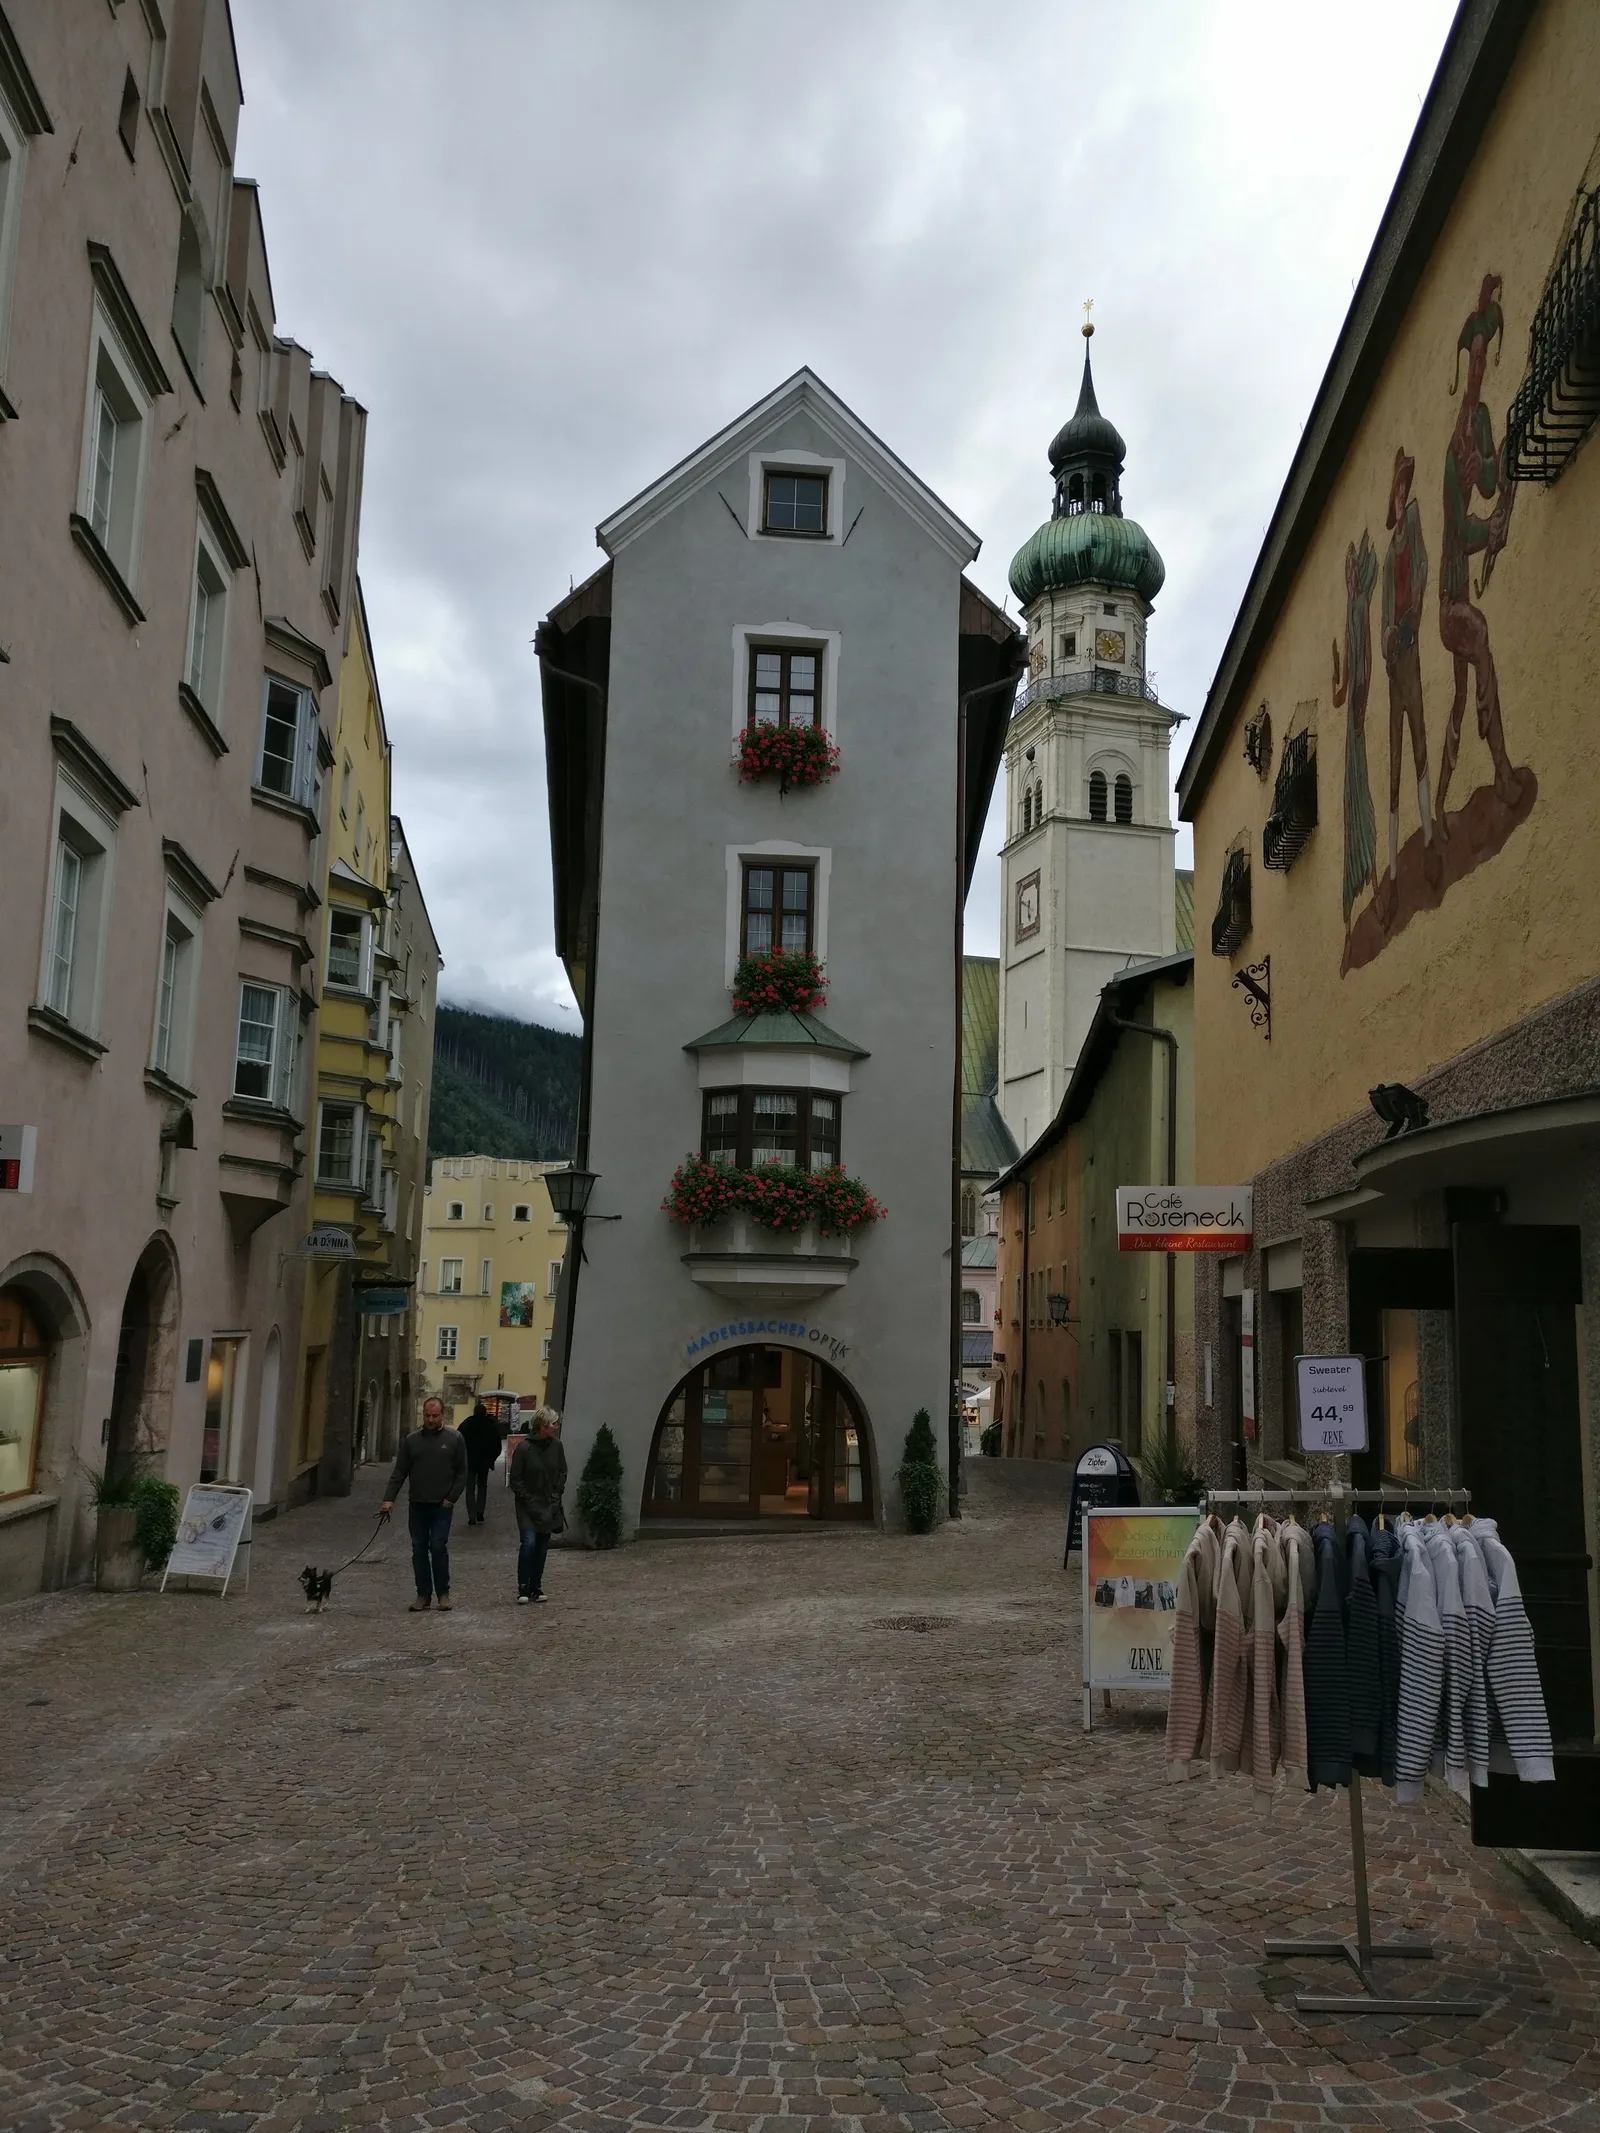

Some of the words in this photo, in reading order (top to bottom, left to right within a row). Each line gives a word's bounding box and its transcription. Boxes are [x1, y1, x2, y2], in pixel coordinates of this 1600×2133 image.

[1144, 1192, 1183, 1209] Café
[1127, 1201, 1245, 1227] Roseneck
[307, 1236, 318, 1247] LA
[1156, 1237, 1183, 1249] kleine
[1186, 1236, 1238, 1250] Restaurant
[686, 1319, 806, 1357] MADERSBACHER
[808, 1328, 852, 1361] OPTIK
[1308, 1366, 1352, 1375] Sweater
[1311, 1385, 1348, 1395] Sublevel
[1322, 1430, 1344, 1445] ZENE
[1087, 1457, 1108, 1467] Zipfer
[1130, 1647, 1163, 1671] ZENE
